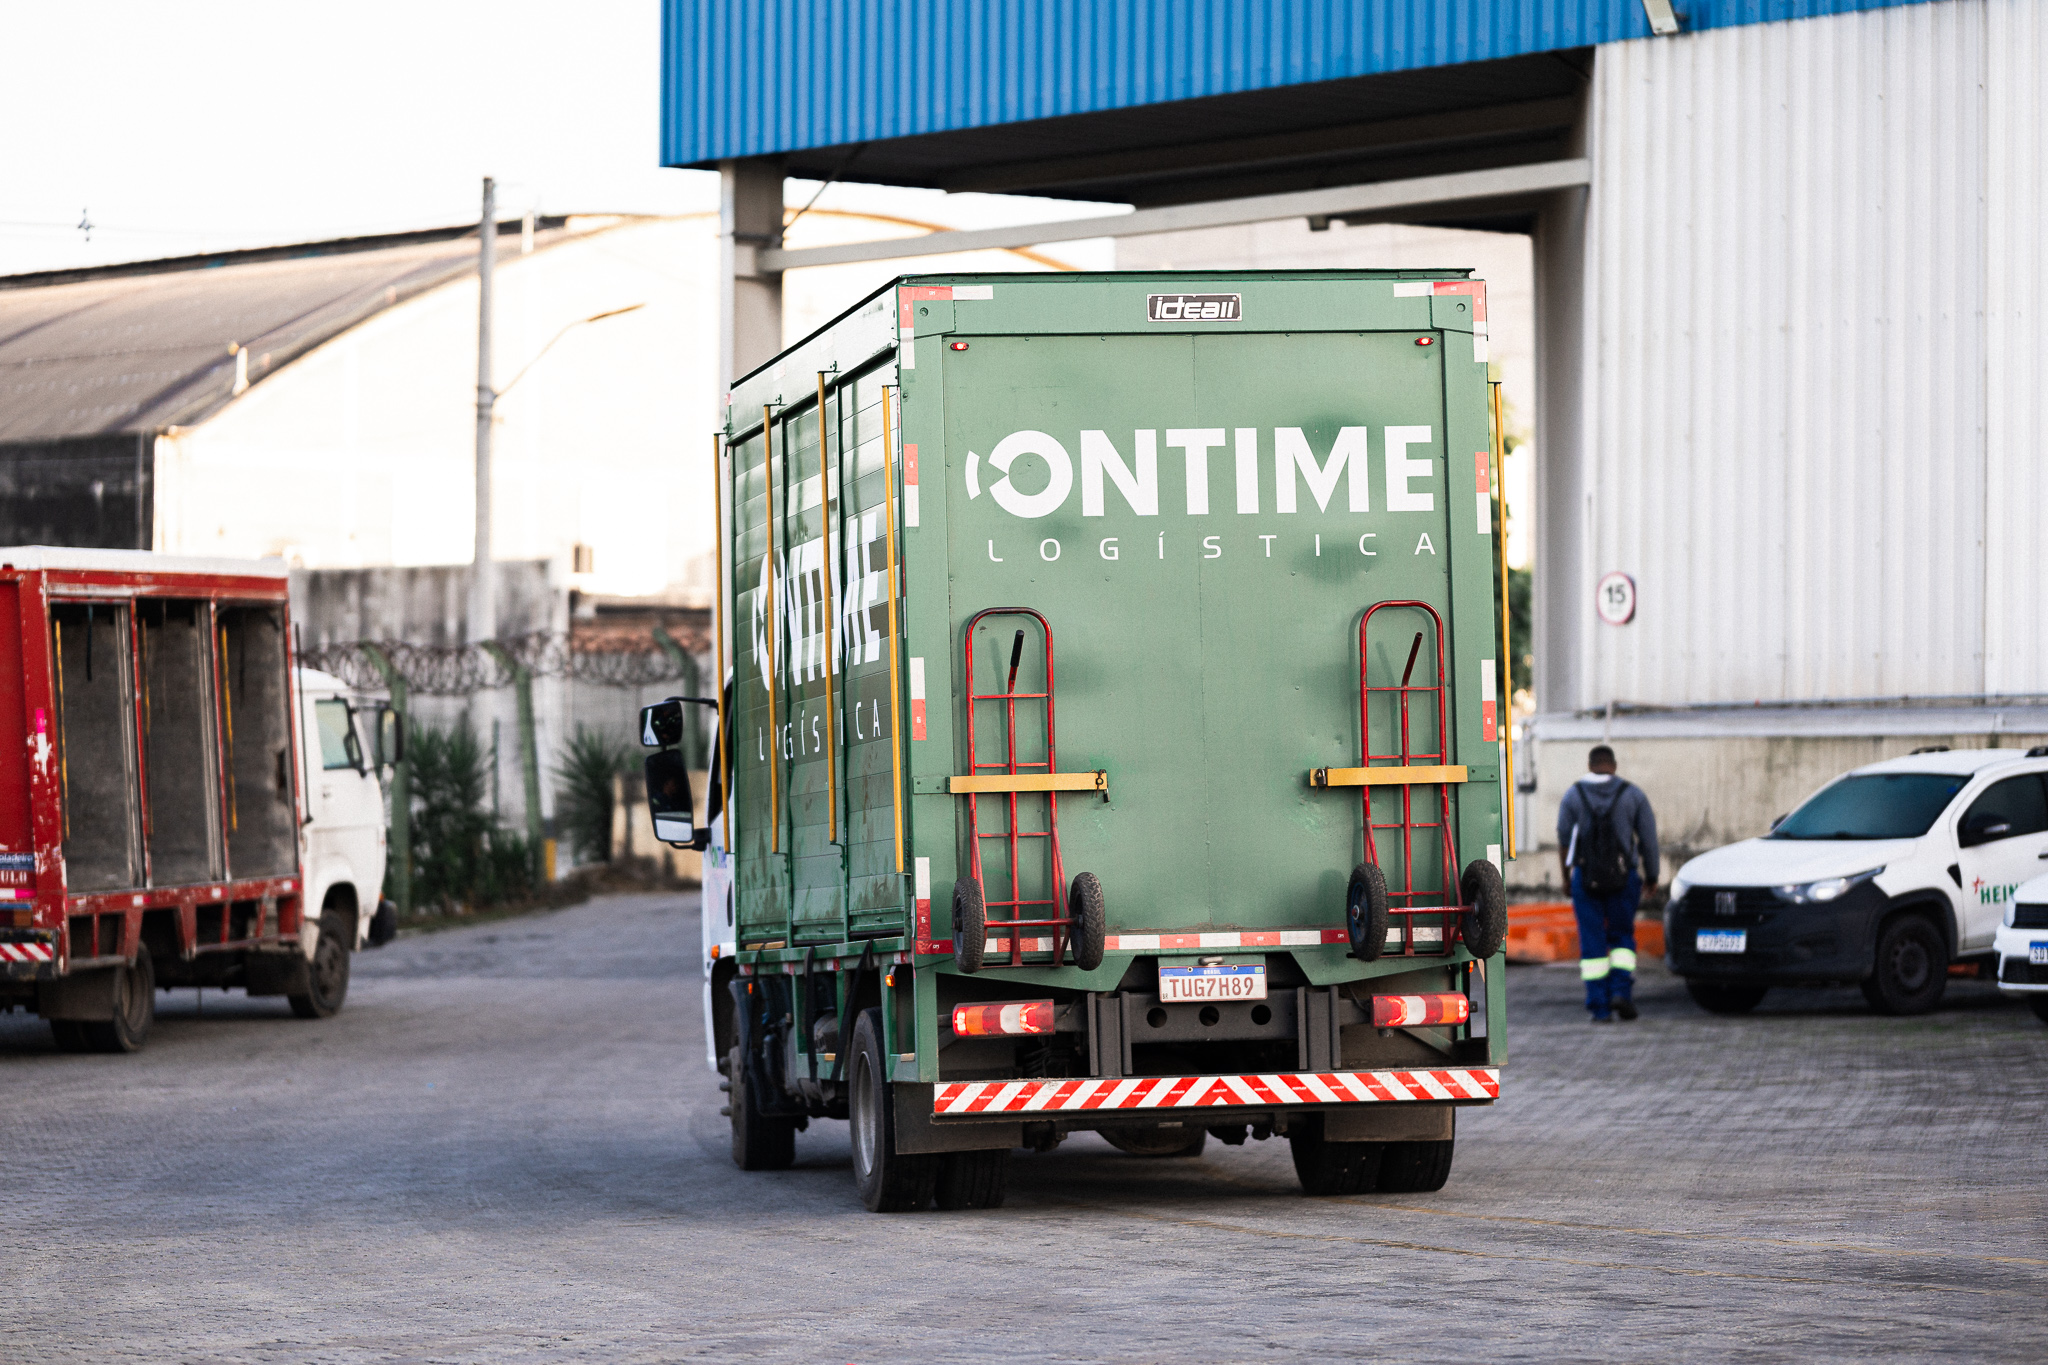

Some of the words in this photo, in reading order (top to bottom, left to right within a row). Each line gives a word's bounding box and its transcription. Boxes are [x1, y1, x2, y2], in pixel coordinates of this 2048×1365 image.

[965, 425, 1435, 519] ONTIME
[988, 531, 1437, 563] LOGÍSTICA
[1606, 584, 1626, 604] 15
[759, 698, 881, 762] LGÍSICA
[2033, 947, 2048, 961] SD
[1169, 976, 1254, 998] TUG7H89
